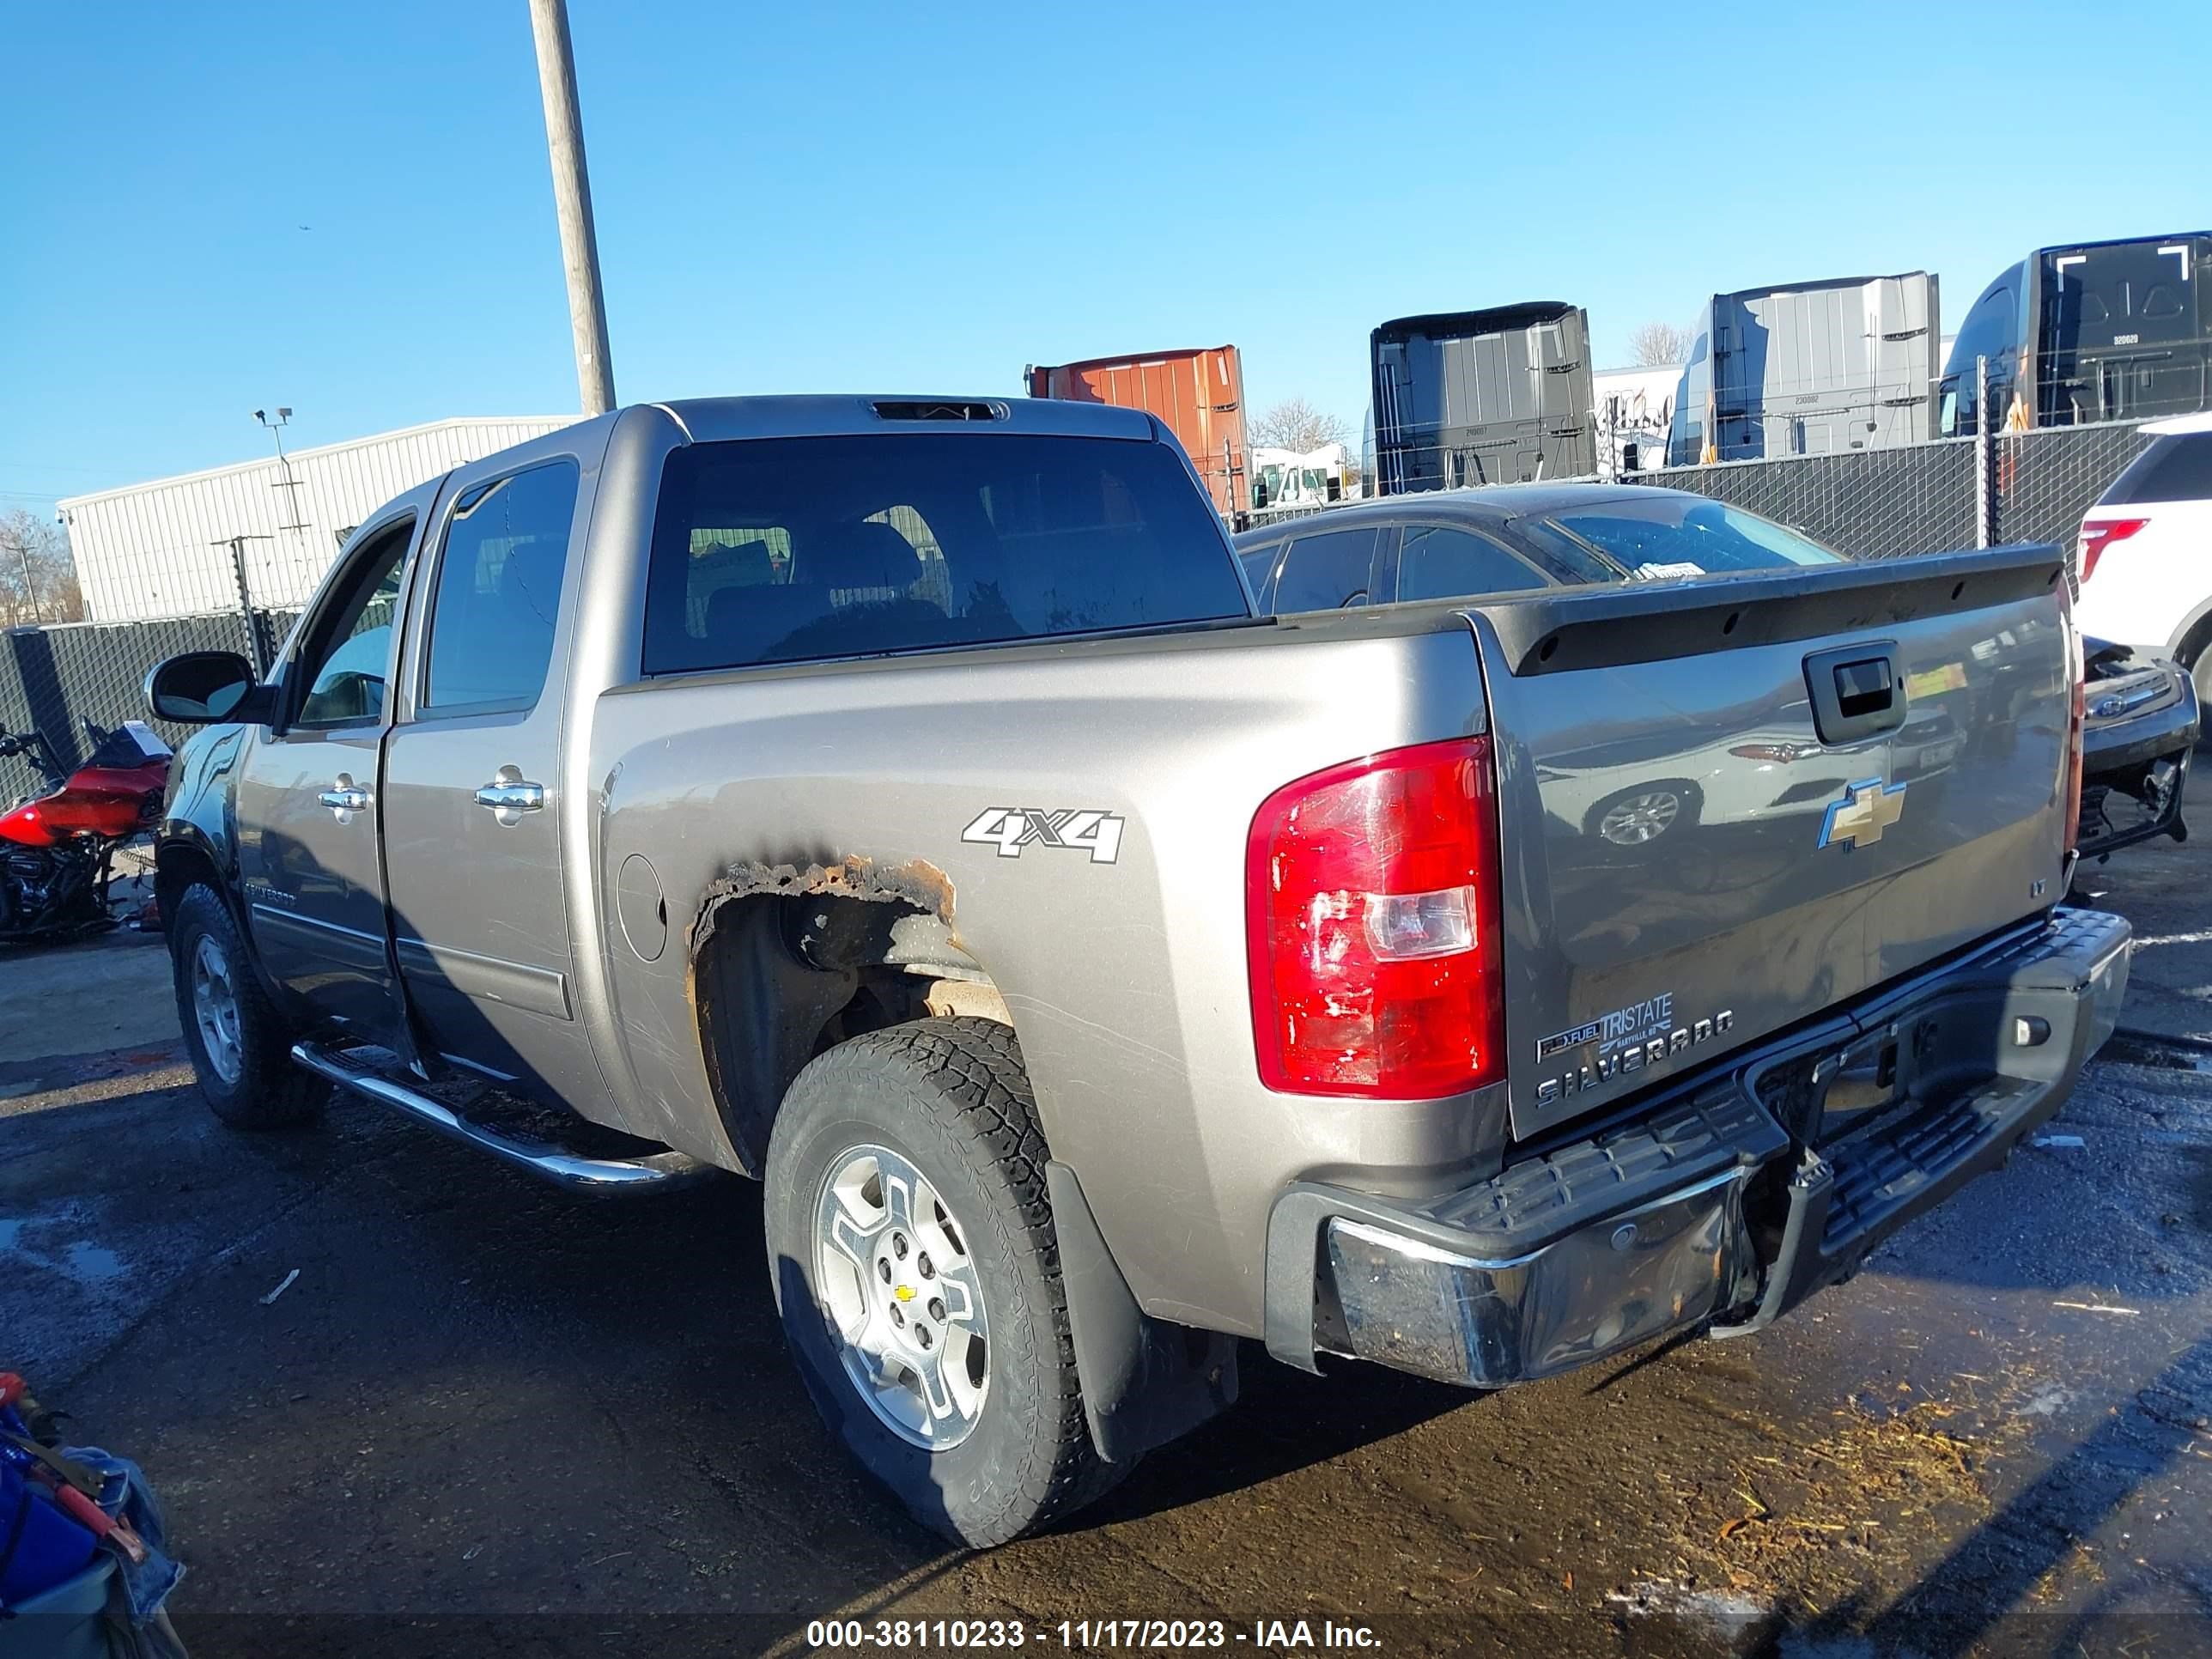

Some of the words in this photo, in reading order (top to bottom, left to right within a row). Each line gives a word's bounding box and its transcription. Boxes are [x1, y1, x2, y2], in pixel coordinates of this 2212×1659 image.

[961, 806, 1126, 865] 4X4
[1600, 992, 1674, 1041] TRISTATE
[1536, 1009, 1734, 1109] SILVERADO
